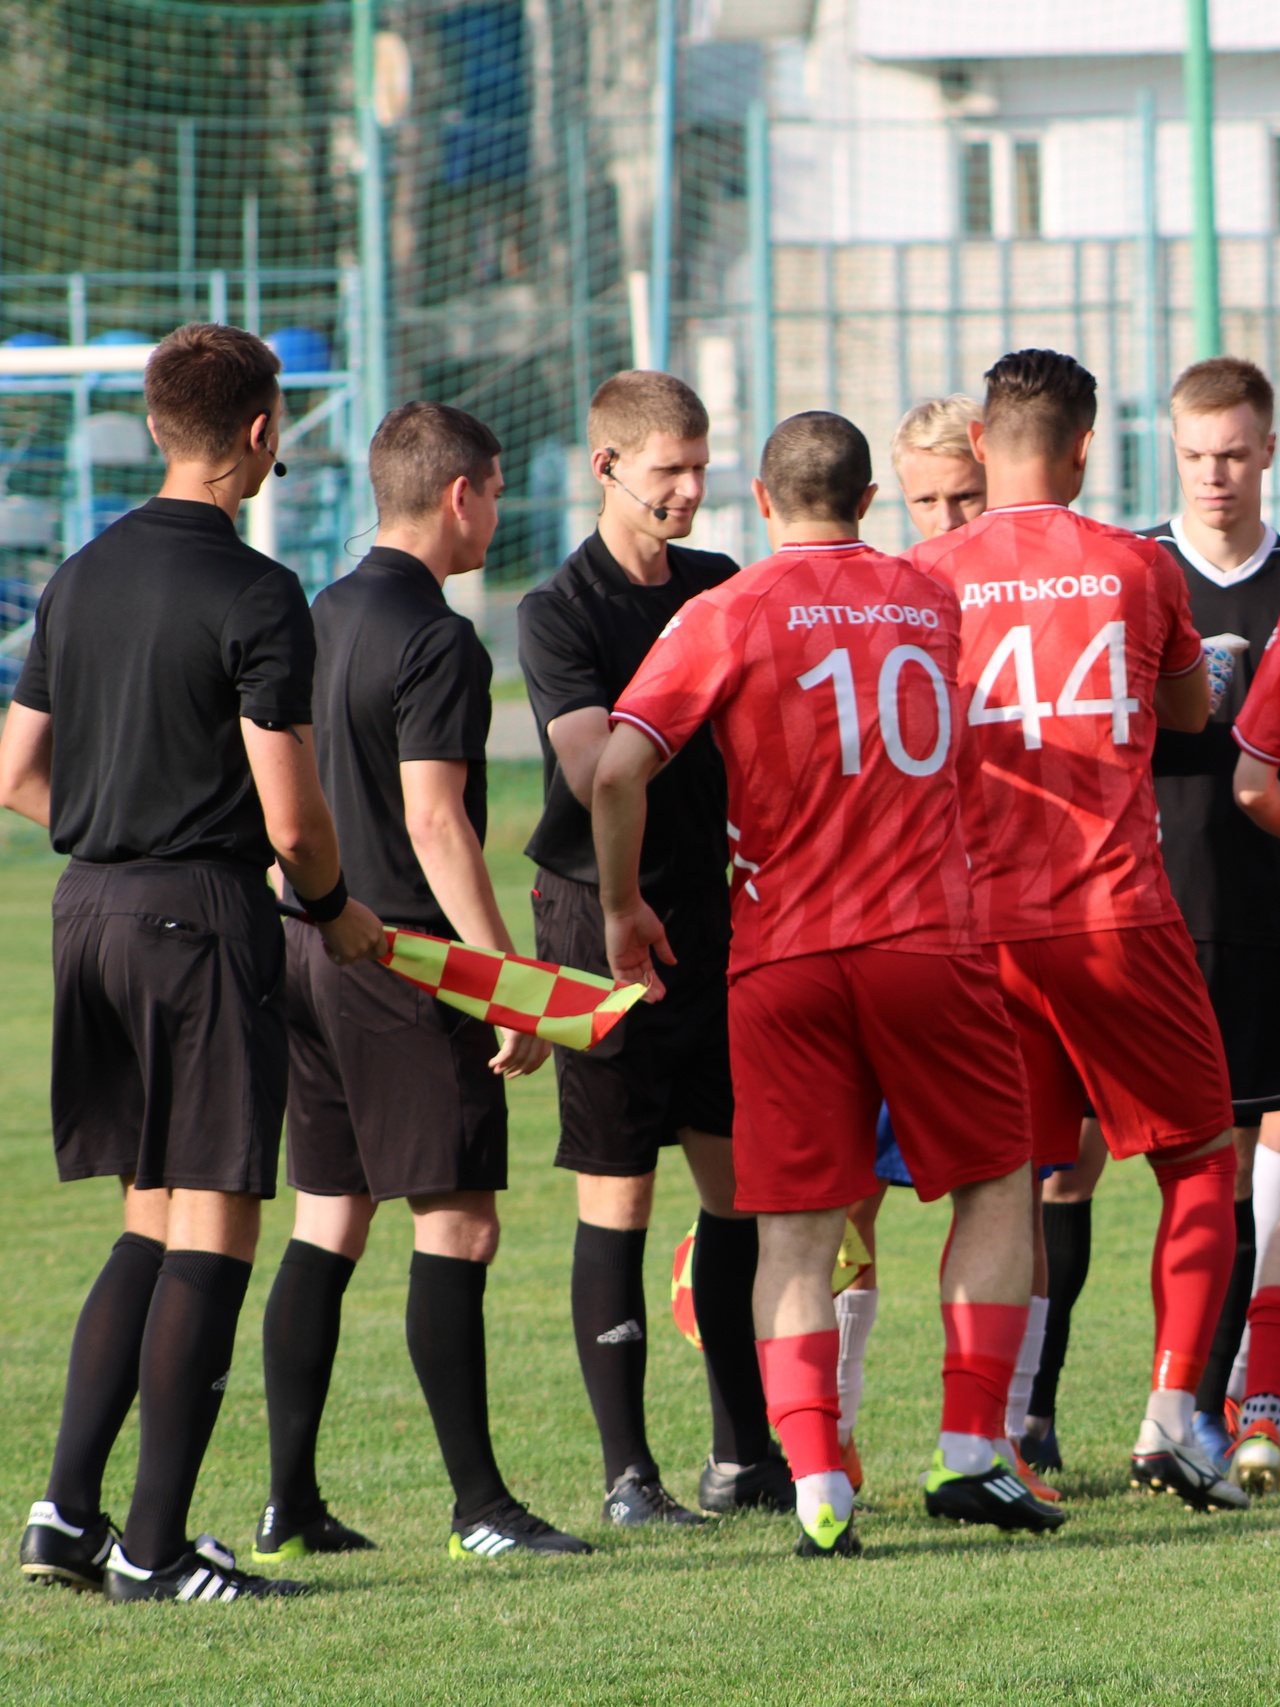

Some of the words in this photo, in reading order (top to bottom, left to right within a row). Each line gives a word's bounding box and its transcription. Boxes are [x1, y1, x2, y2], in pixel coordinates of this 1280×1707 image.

[787, 604, 940, 631] ДЯТЬКОВО
[961, 574, 1122, 610] ДЯТЬКОВО
[796, 643, 950, 776] 10
[968, 620, 1139, 750] 44
